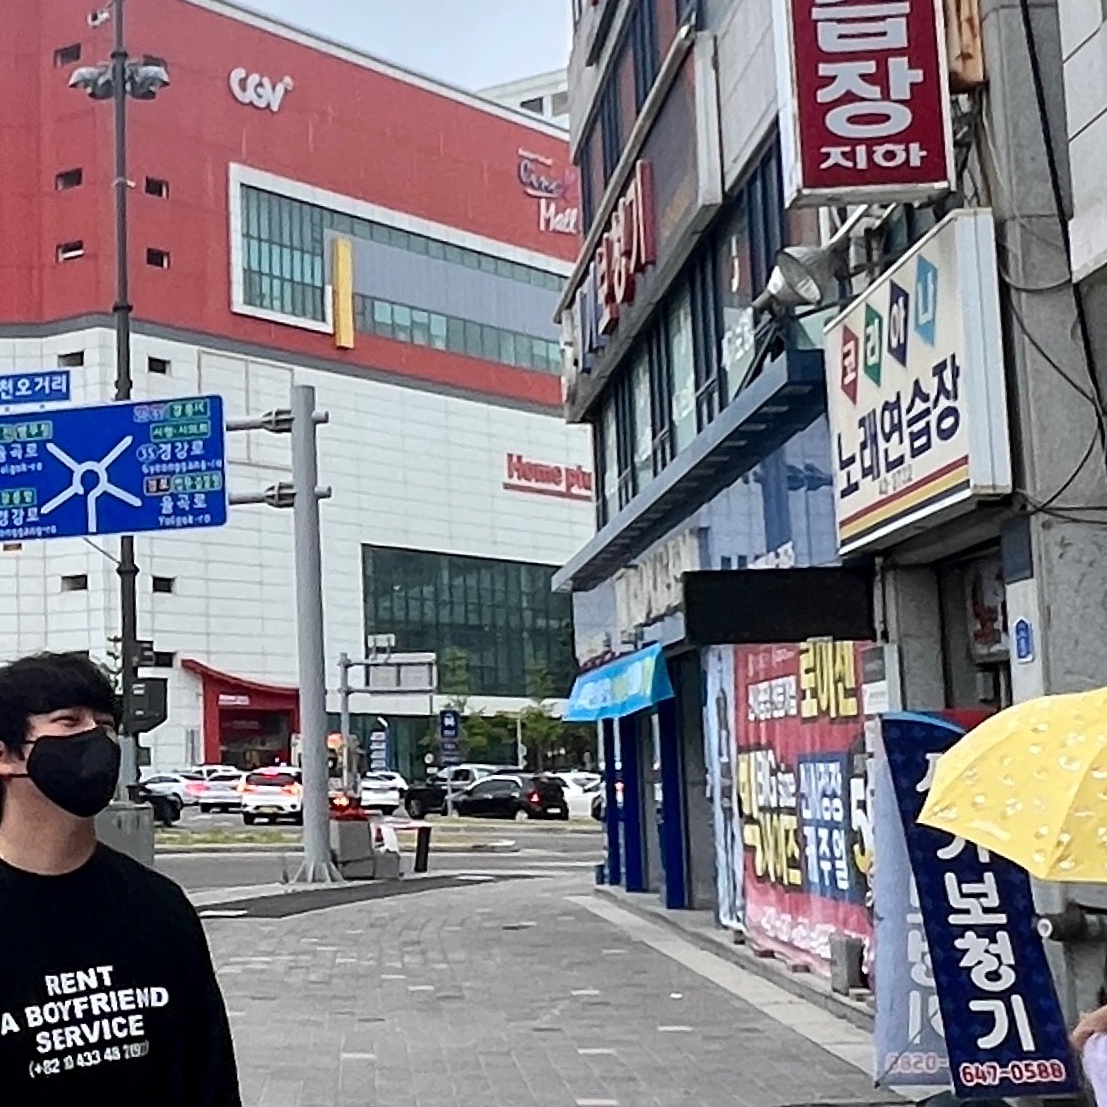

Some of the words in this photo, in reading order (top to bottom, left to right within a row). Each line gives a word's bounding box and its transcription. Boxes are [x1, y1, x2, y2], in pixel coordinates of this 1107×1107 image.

[229, 67, 288, 112] CGV
[819, 143, 927, 170] 지하
[842, 270, 935, 385] 코리아나
[837, 353, 961, 498] 노래연습장
[158, 440, 205, 461] 경강로
[505, 452, 563, 486] Home
[564, 464, 593, 496] plu
[160, 493, 207, 515] 율곡로
[45, 965, 114, 996] RENT
[0, 1012, 21, 1035] A
[24, 987, 170, 1028] BOYFRIEND
[35, 1014, 145, 1054] SERVICE
[76, 1050, 102, 1068] 433
[958, 1058, 1067, 1087] 647-0588
